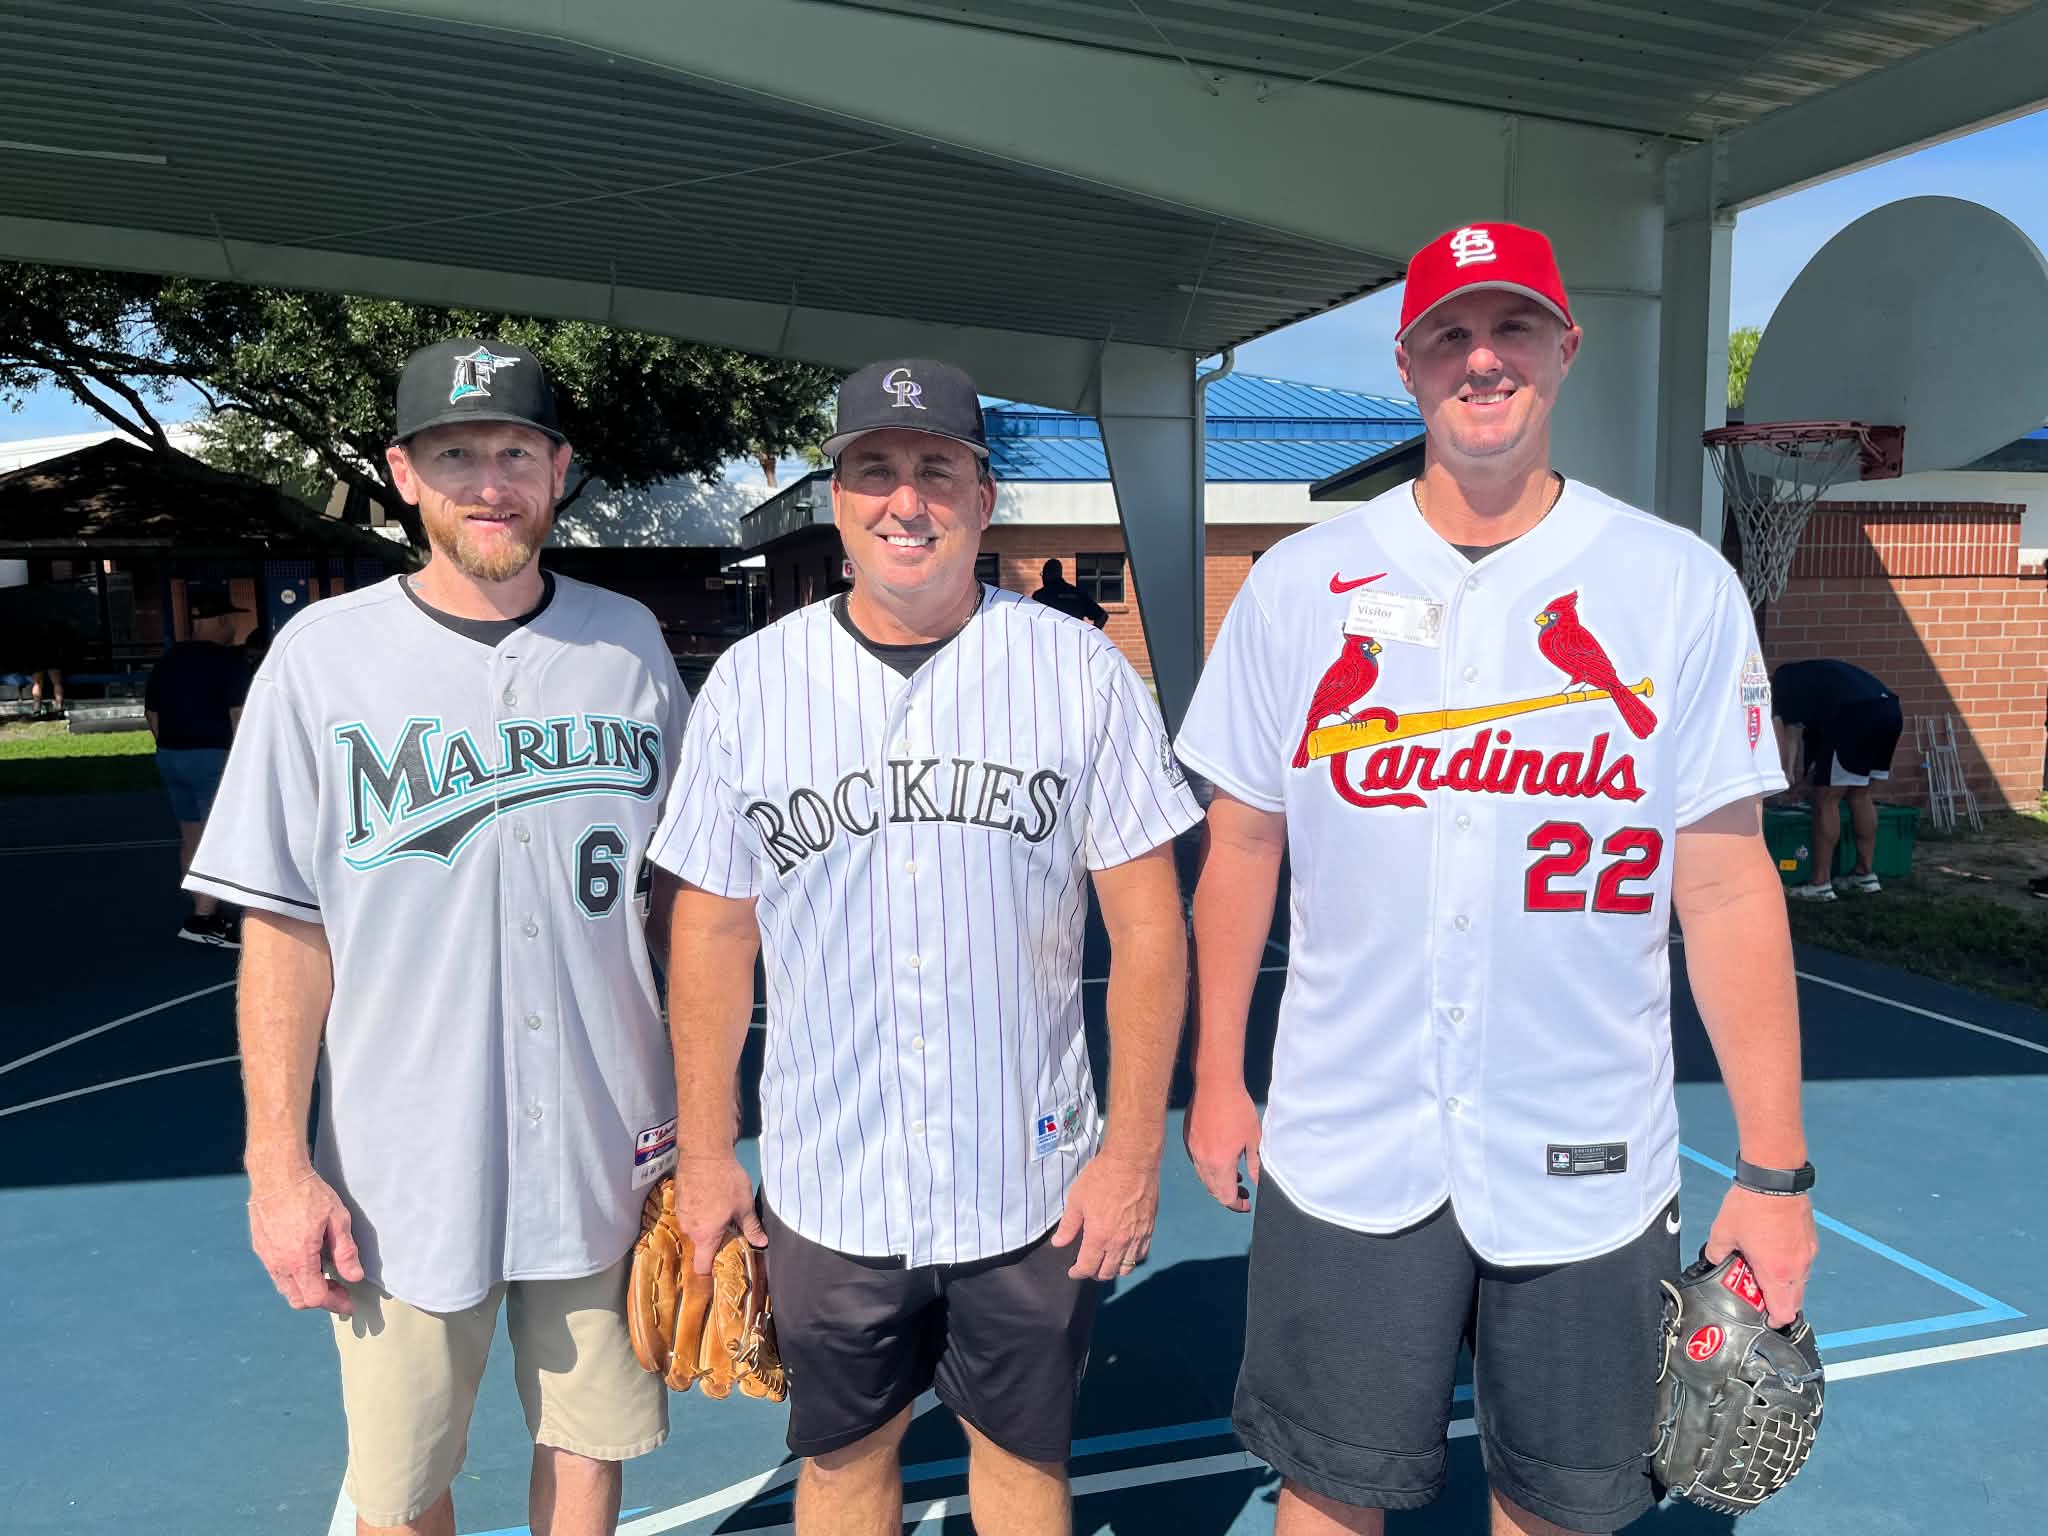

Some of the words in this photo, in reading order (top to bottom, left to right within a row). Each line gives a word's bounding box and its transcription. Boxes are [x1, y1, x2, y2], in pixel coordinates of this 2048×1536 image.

[882, 367, 928, 410] CR
[1357, 605, 1392, 618] Visitor
[334, 714, 662, 849] MARLINS
[1330, 706, 1647, 809] Cardinals
[744, 756, 1068, 877] ROCKIES
[1524, 820, 1664, 914] 22
